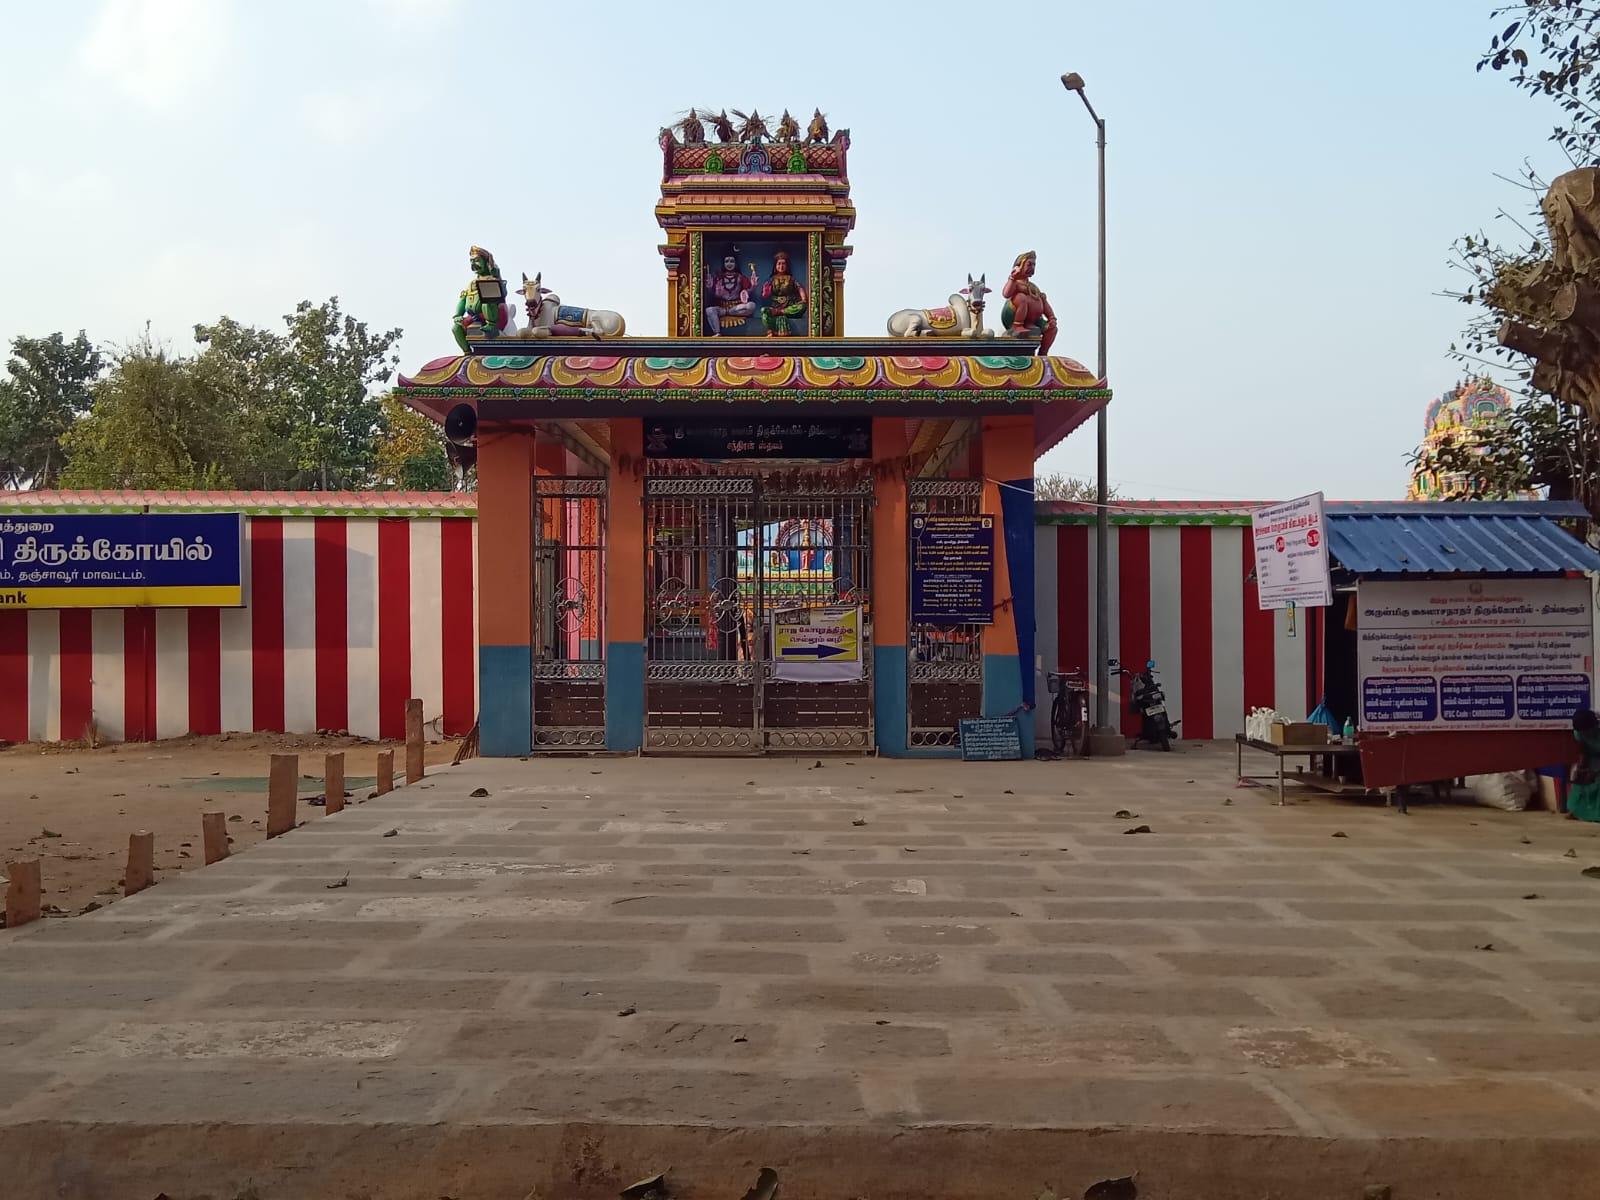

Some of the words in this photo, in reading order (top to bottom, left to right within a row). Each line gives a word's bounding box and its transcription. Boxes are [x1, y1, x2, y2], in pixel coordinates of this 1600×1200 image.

[12, 536, 213, 566] திருக்கோயில்
[18, 569, 78, 583] தஞ்சாவூர்
[82, 568, 146, 580] மாவட்டம்.
[1364, 607, 1410, 618] அருள்மிகு
[1411, 605, 1471, 618] கைலாசநாதர்
[1474, 604, 1533, 616] திருக்கோயில்
